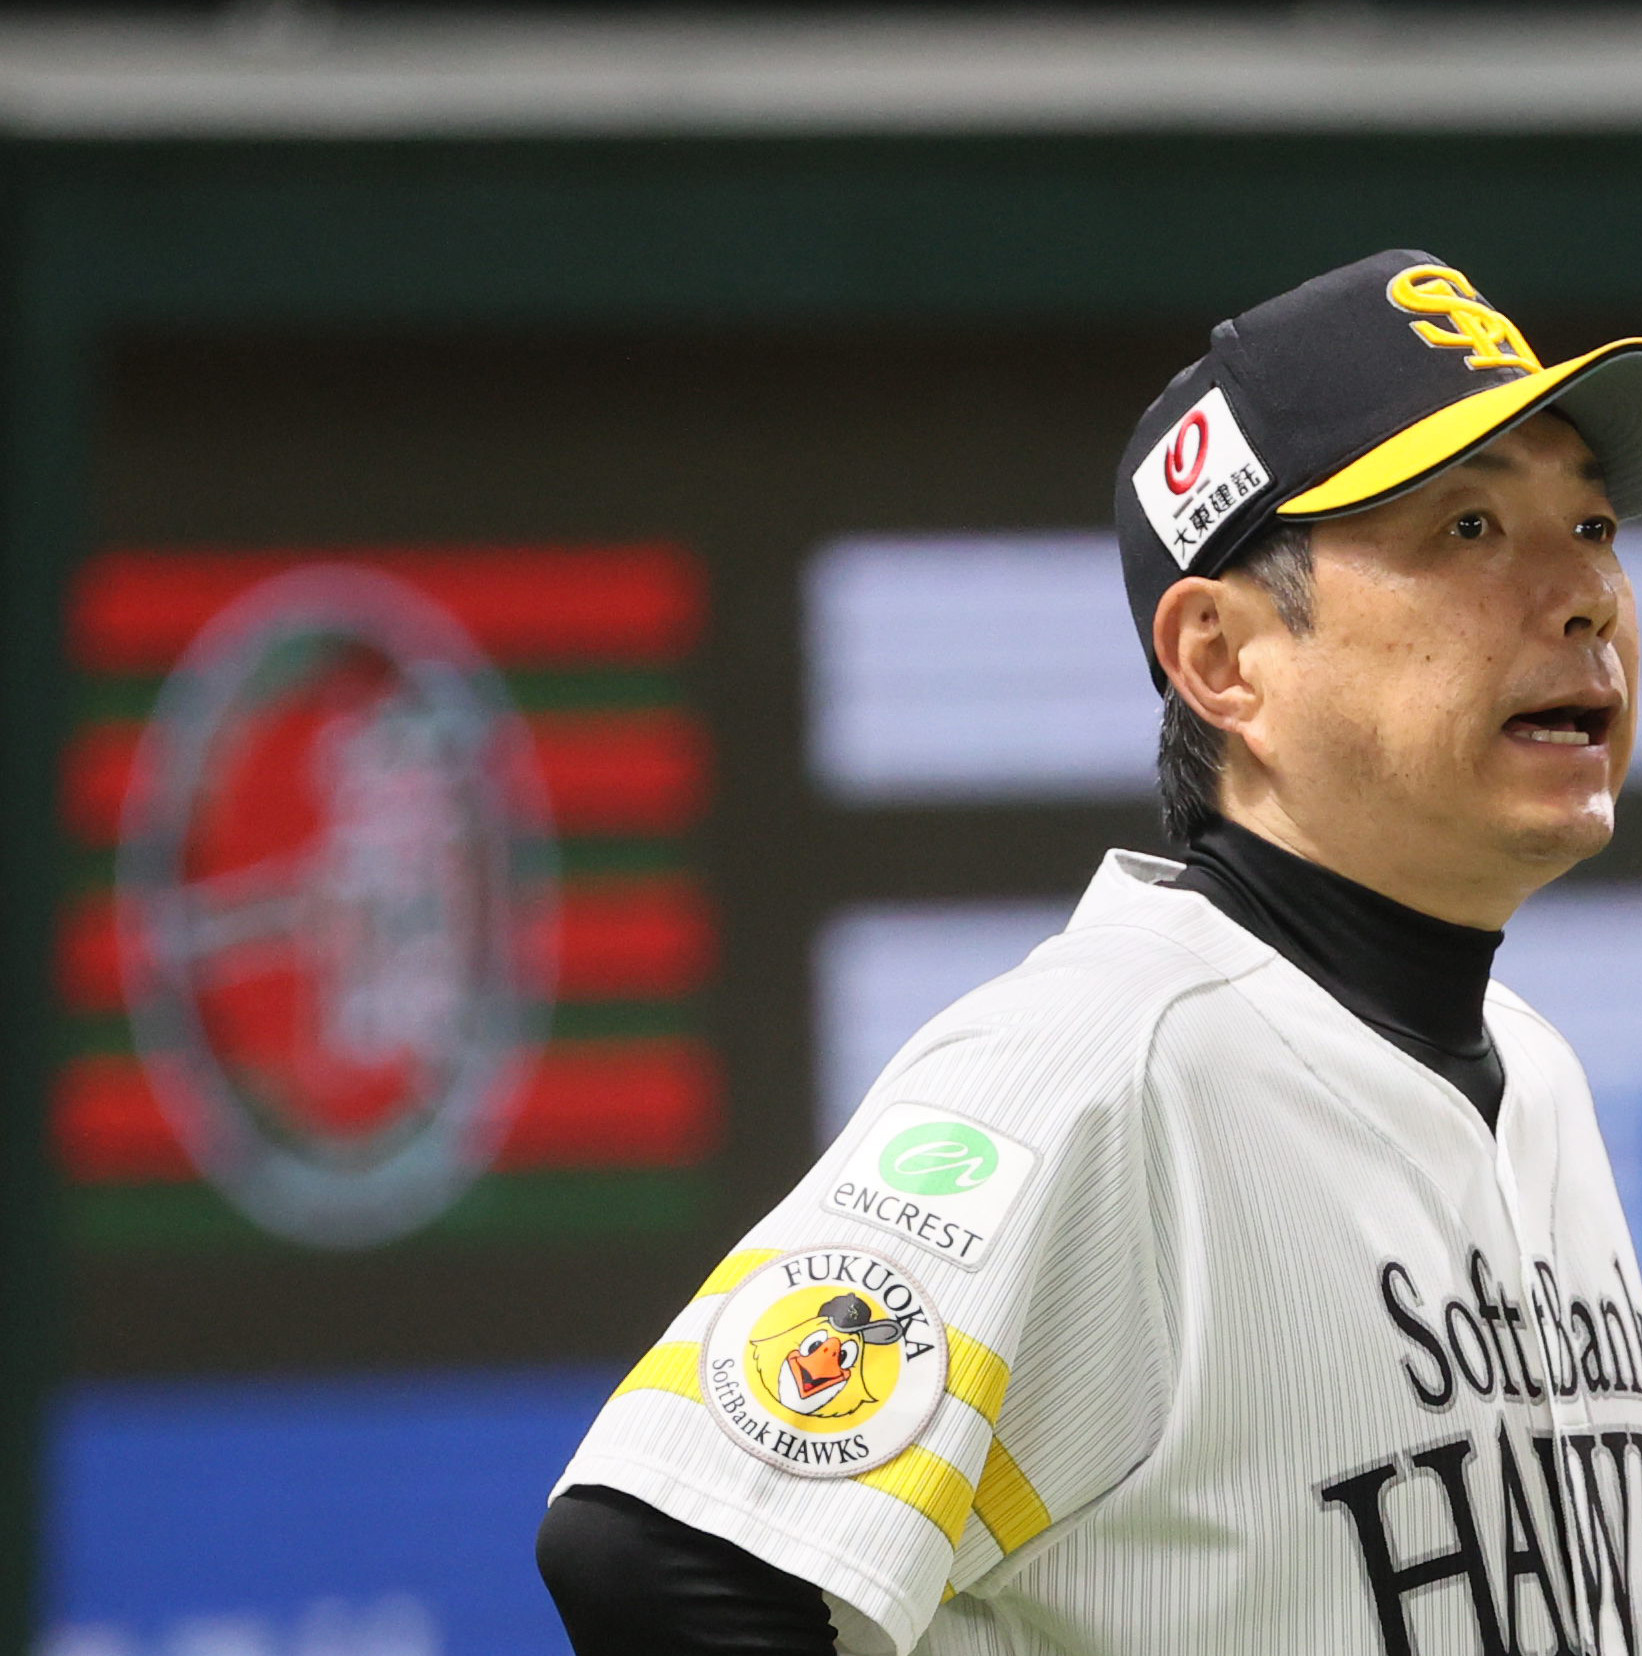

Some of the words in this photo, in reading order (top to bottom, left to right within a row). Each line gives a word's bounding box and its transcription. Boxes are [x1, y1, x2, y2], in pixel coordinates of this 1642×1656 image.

[1173, 463, 1261, 560] 大東建託
[781, 1253, 936, 1364] FUKUOKA
[711, 1358, 775, 1446] SoftBank
[773, 1431, 870, 1465] HAWKS
